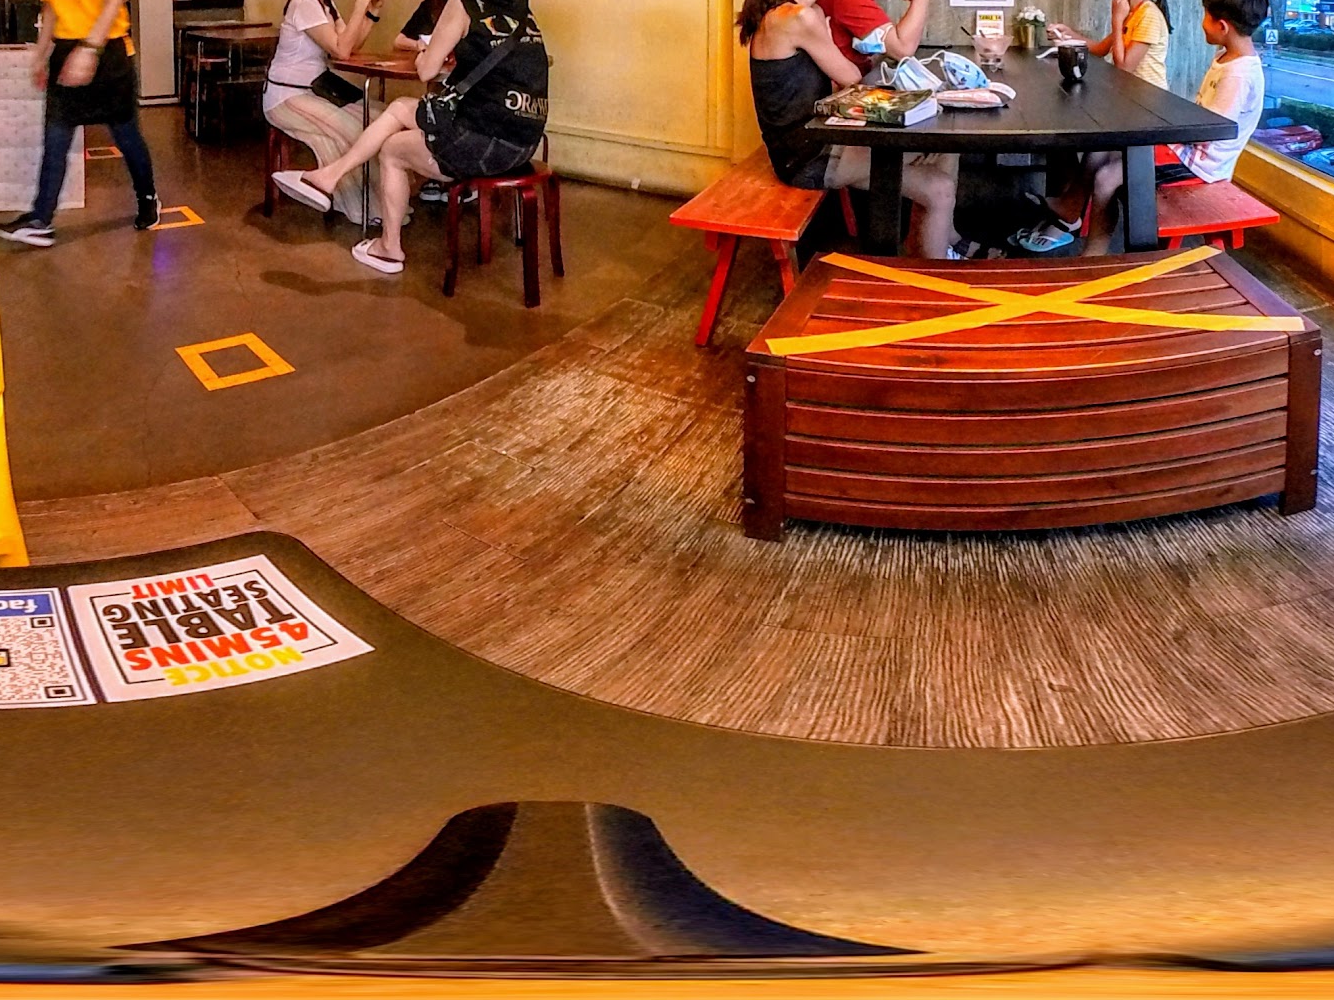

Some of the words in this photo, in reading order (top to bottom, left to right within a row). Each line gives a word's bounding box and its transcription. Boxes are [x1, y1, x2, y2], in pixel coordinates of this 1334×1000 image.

[103, 581, 269, 622] SEATING
[132, 574, 214, 599] LIMIT
[112, 598, 297, 650] TABLE
[163, 647, 304, 686] NOTICE
